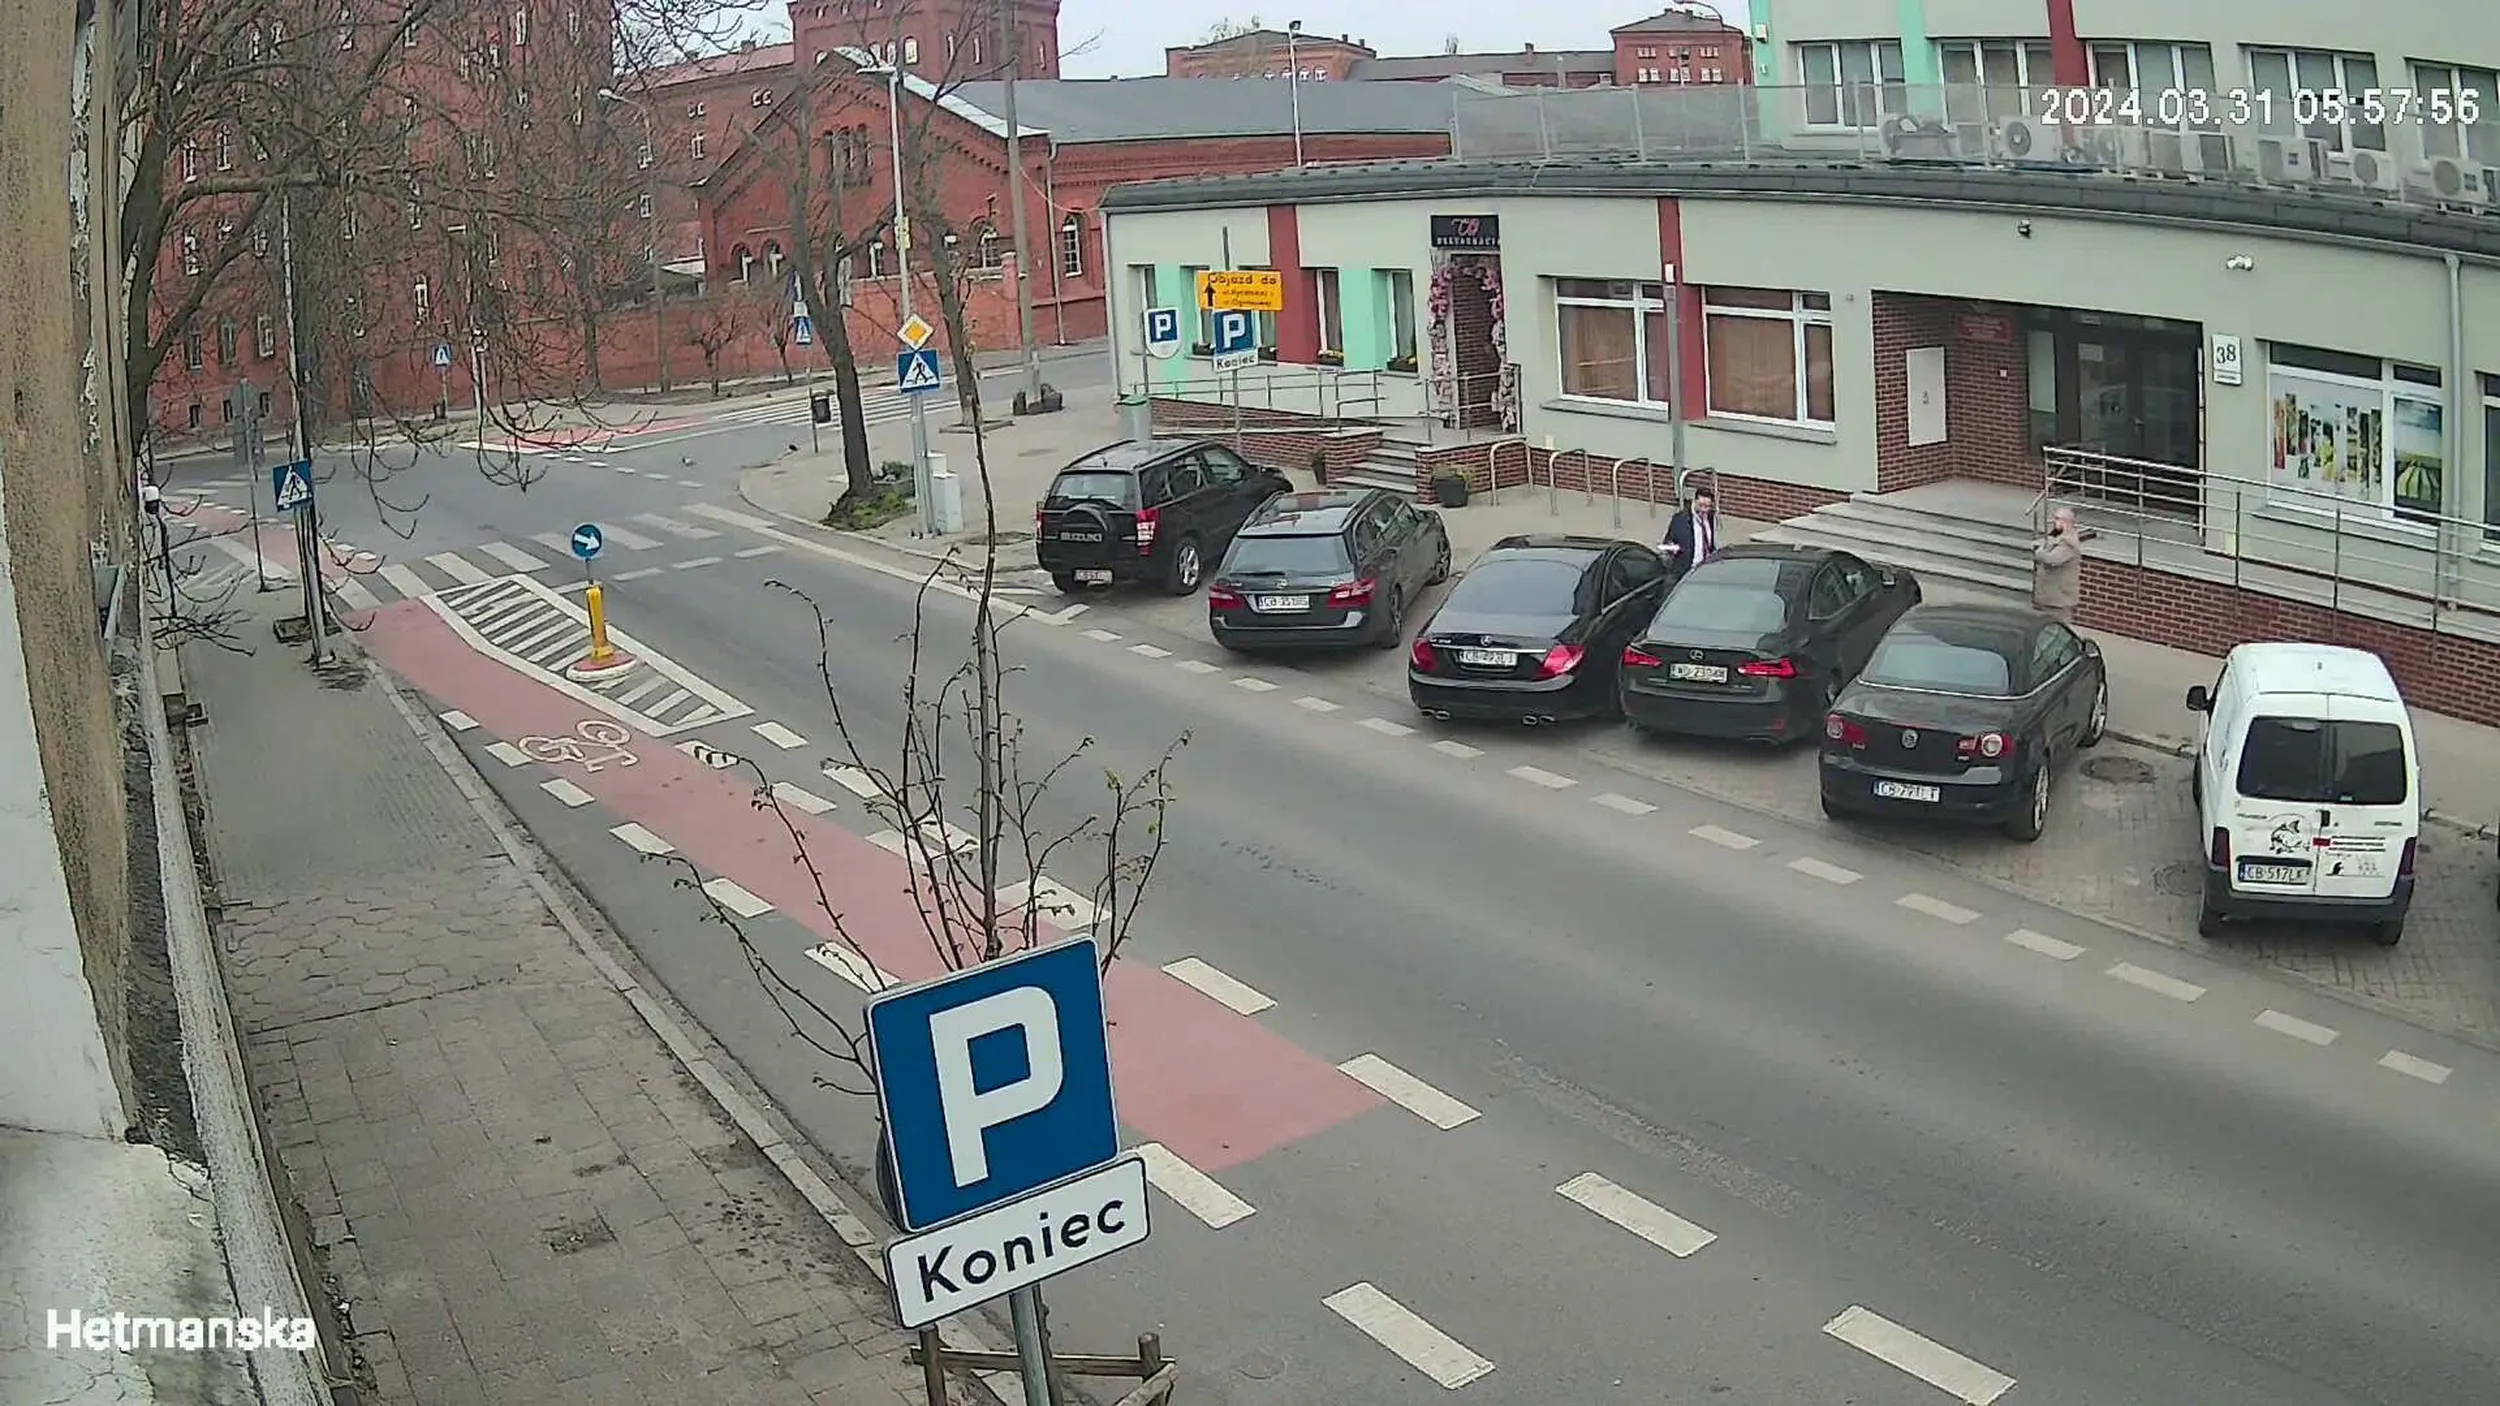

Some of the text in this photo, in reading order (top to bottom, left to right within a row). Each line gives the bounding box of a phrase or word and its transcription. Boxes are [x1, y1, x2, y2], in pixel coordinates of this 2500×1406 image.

[1261, 276, 1277, 285] do
[1155, 314, 1171, 340] P
[1223, 314, 1245, 348] P
[1217, 356, 1255, 370] Koniec
[2217, 344, 2236, 364] 38
[2247, 866, 2263, 879] CB
[929, 986, 1064, 1188] P
[917, 1199, 1125, 1302] Koniec
